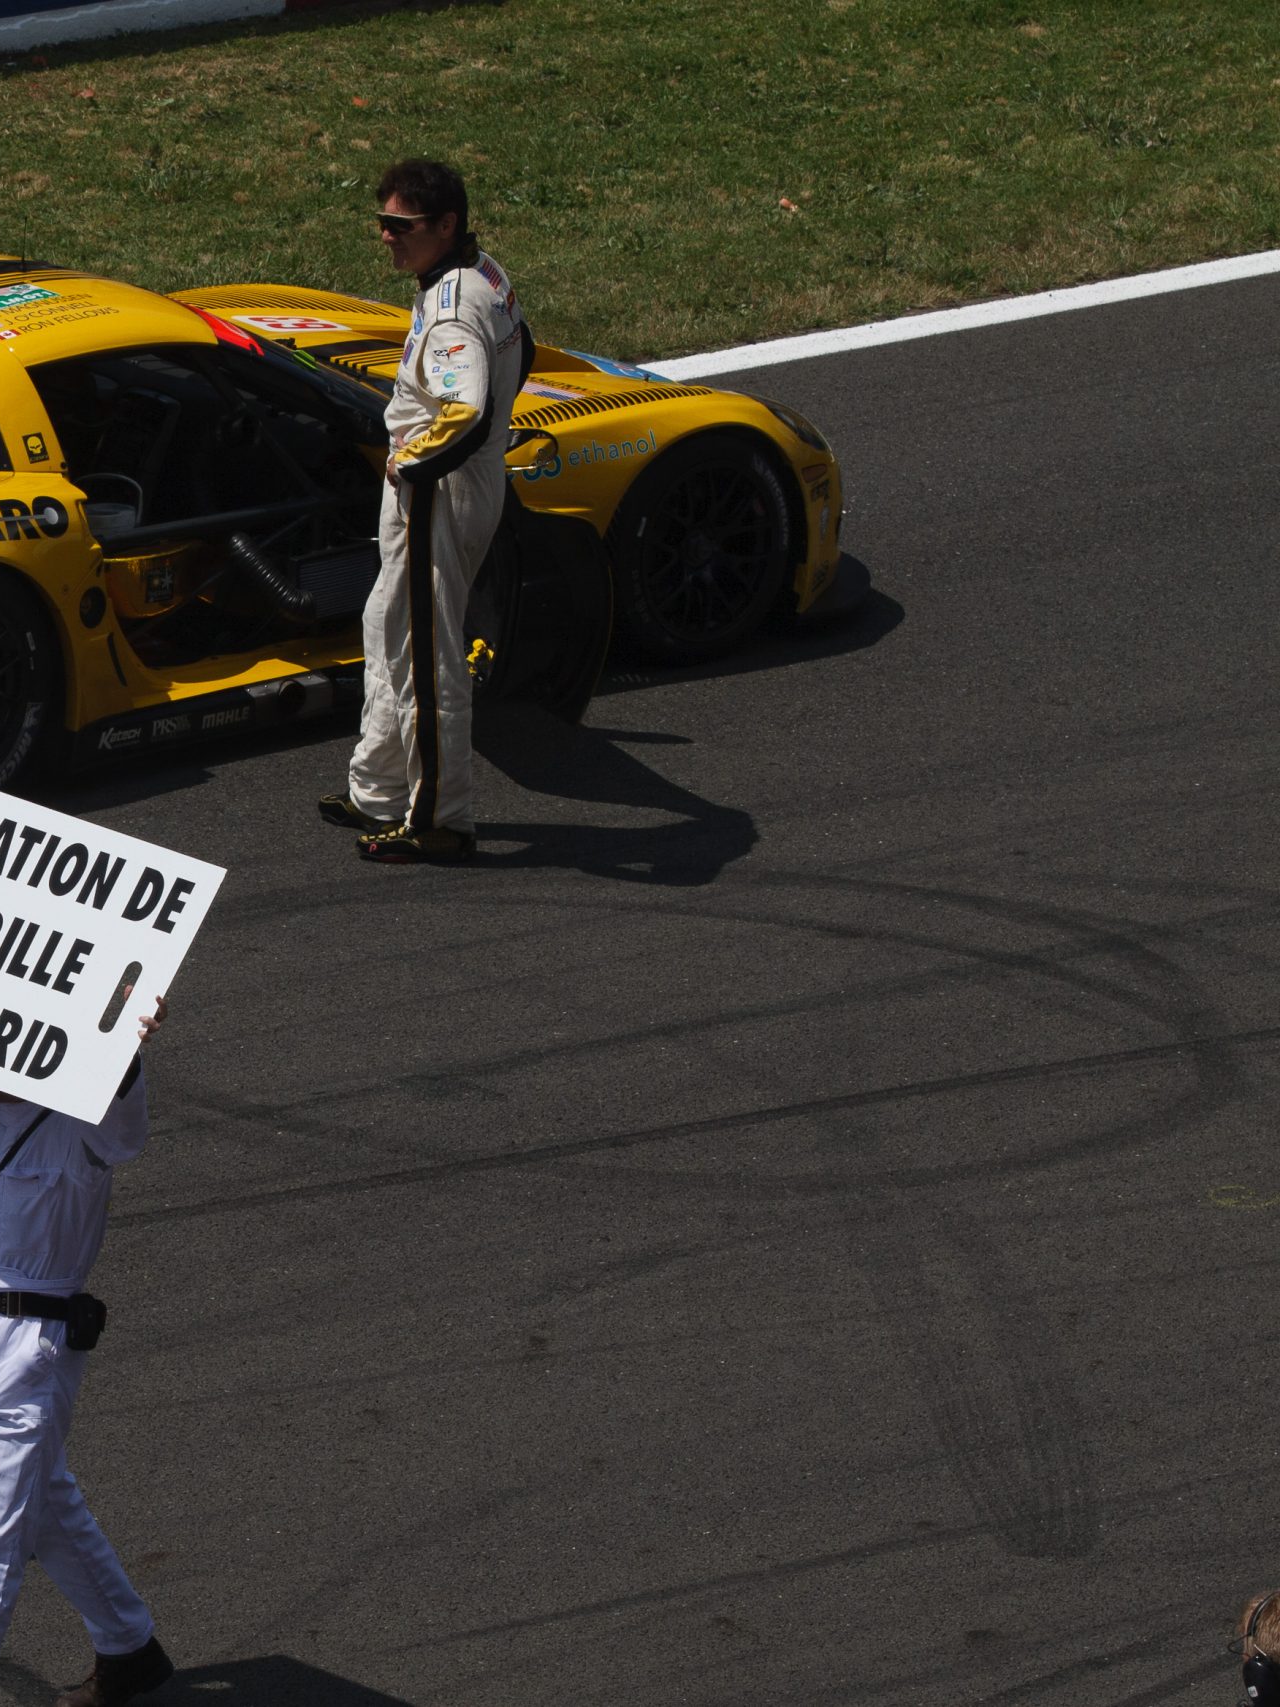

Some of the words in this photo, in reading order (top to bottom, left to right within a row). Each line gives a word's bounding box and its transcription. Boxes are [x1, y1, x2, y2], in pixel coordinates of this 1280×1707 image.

[18, 319, 55, 334] RON
[53, 306, 120, 325] FELLOWS
[569, 427, 657, 466] ethanol
[201, 706, 251, 730] MAHLE
[121, 866, 196, 934] DE
